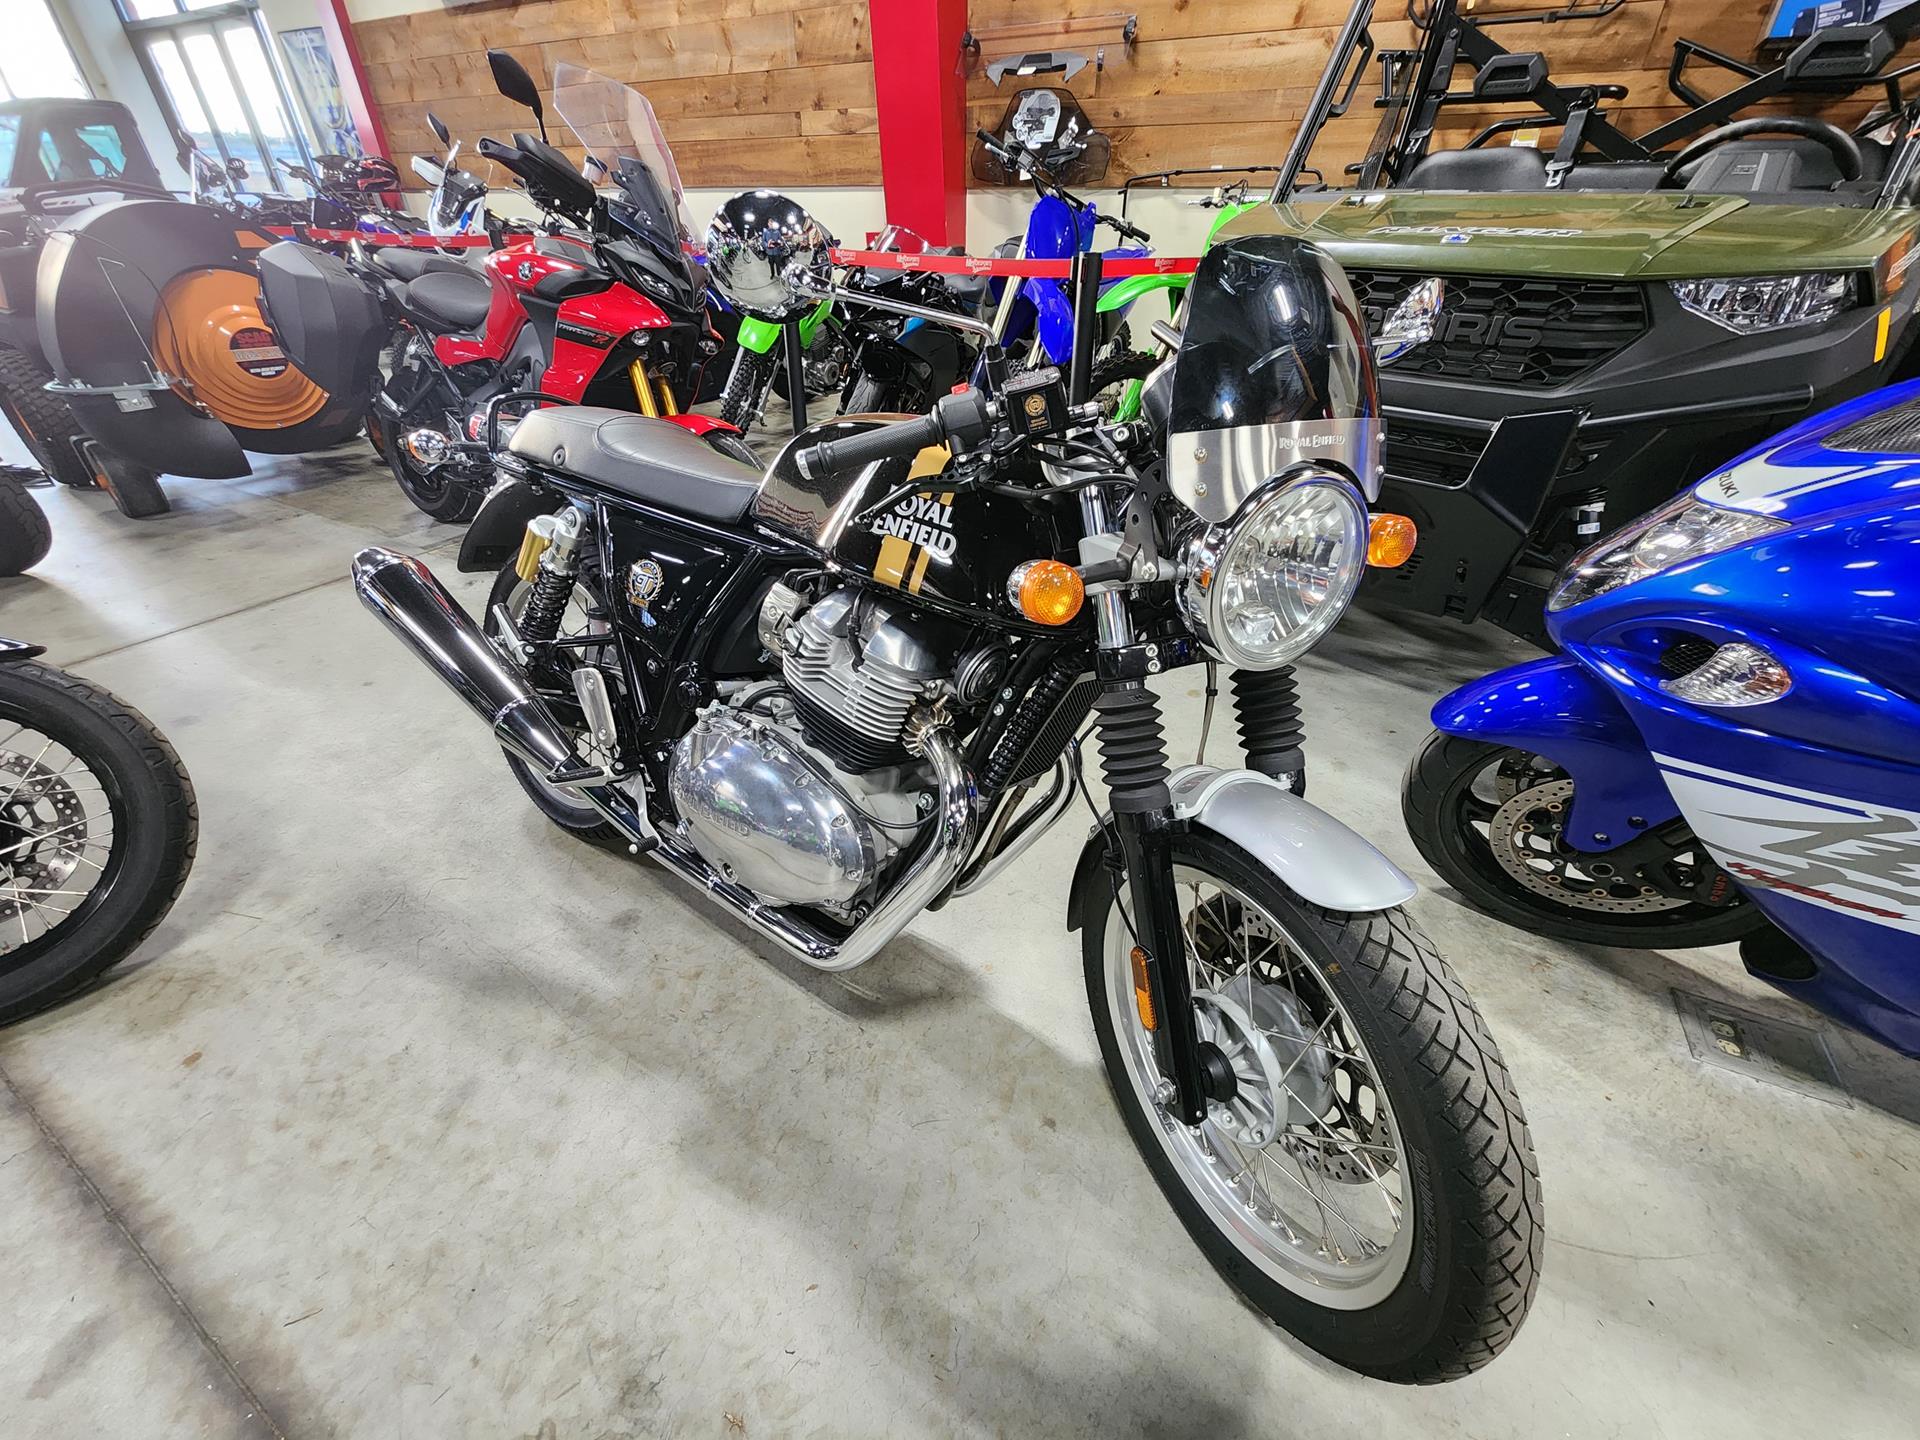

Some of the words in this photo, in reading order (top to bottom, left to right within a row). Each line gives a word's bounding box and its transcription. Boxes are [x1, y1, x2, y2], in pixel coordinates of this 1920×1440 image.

[1366, 226, 1584, 237] RANGER
[1279, 436, 1312, 449] ROYAL
[1312, 434, 1346, 448] ENFIELD
[891, 484, 953, 529] OYAL
[869, 512, 957, 558] ENFIELD
